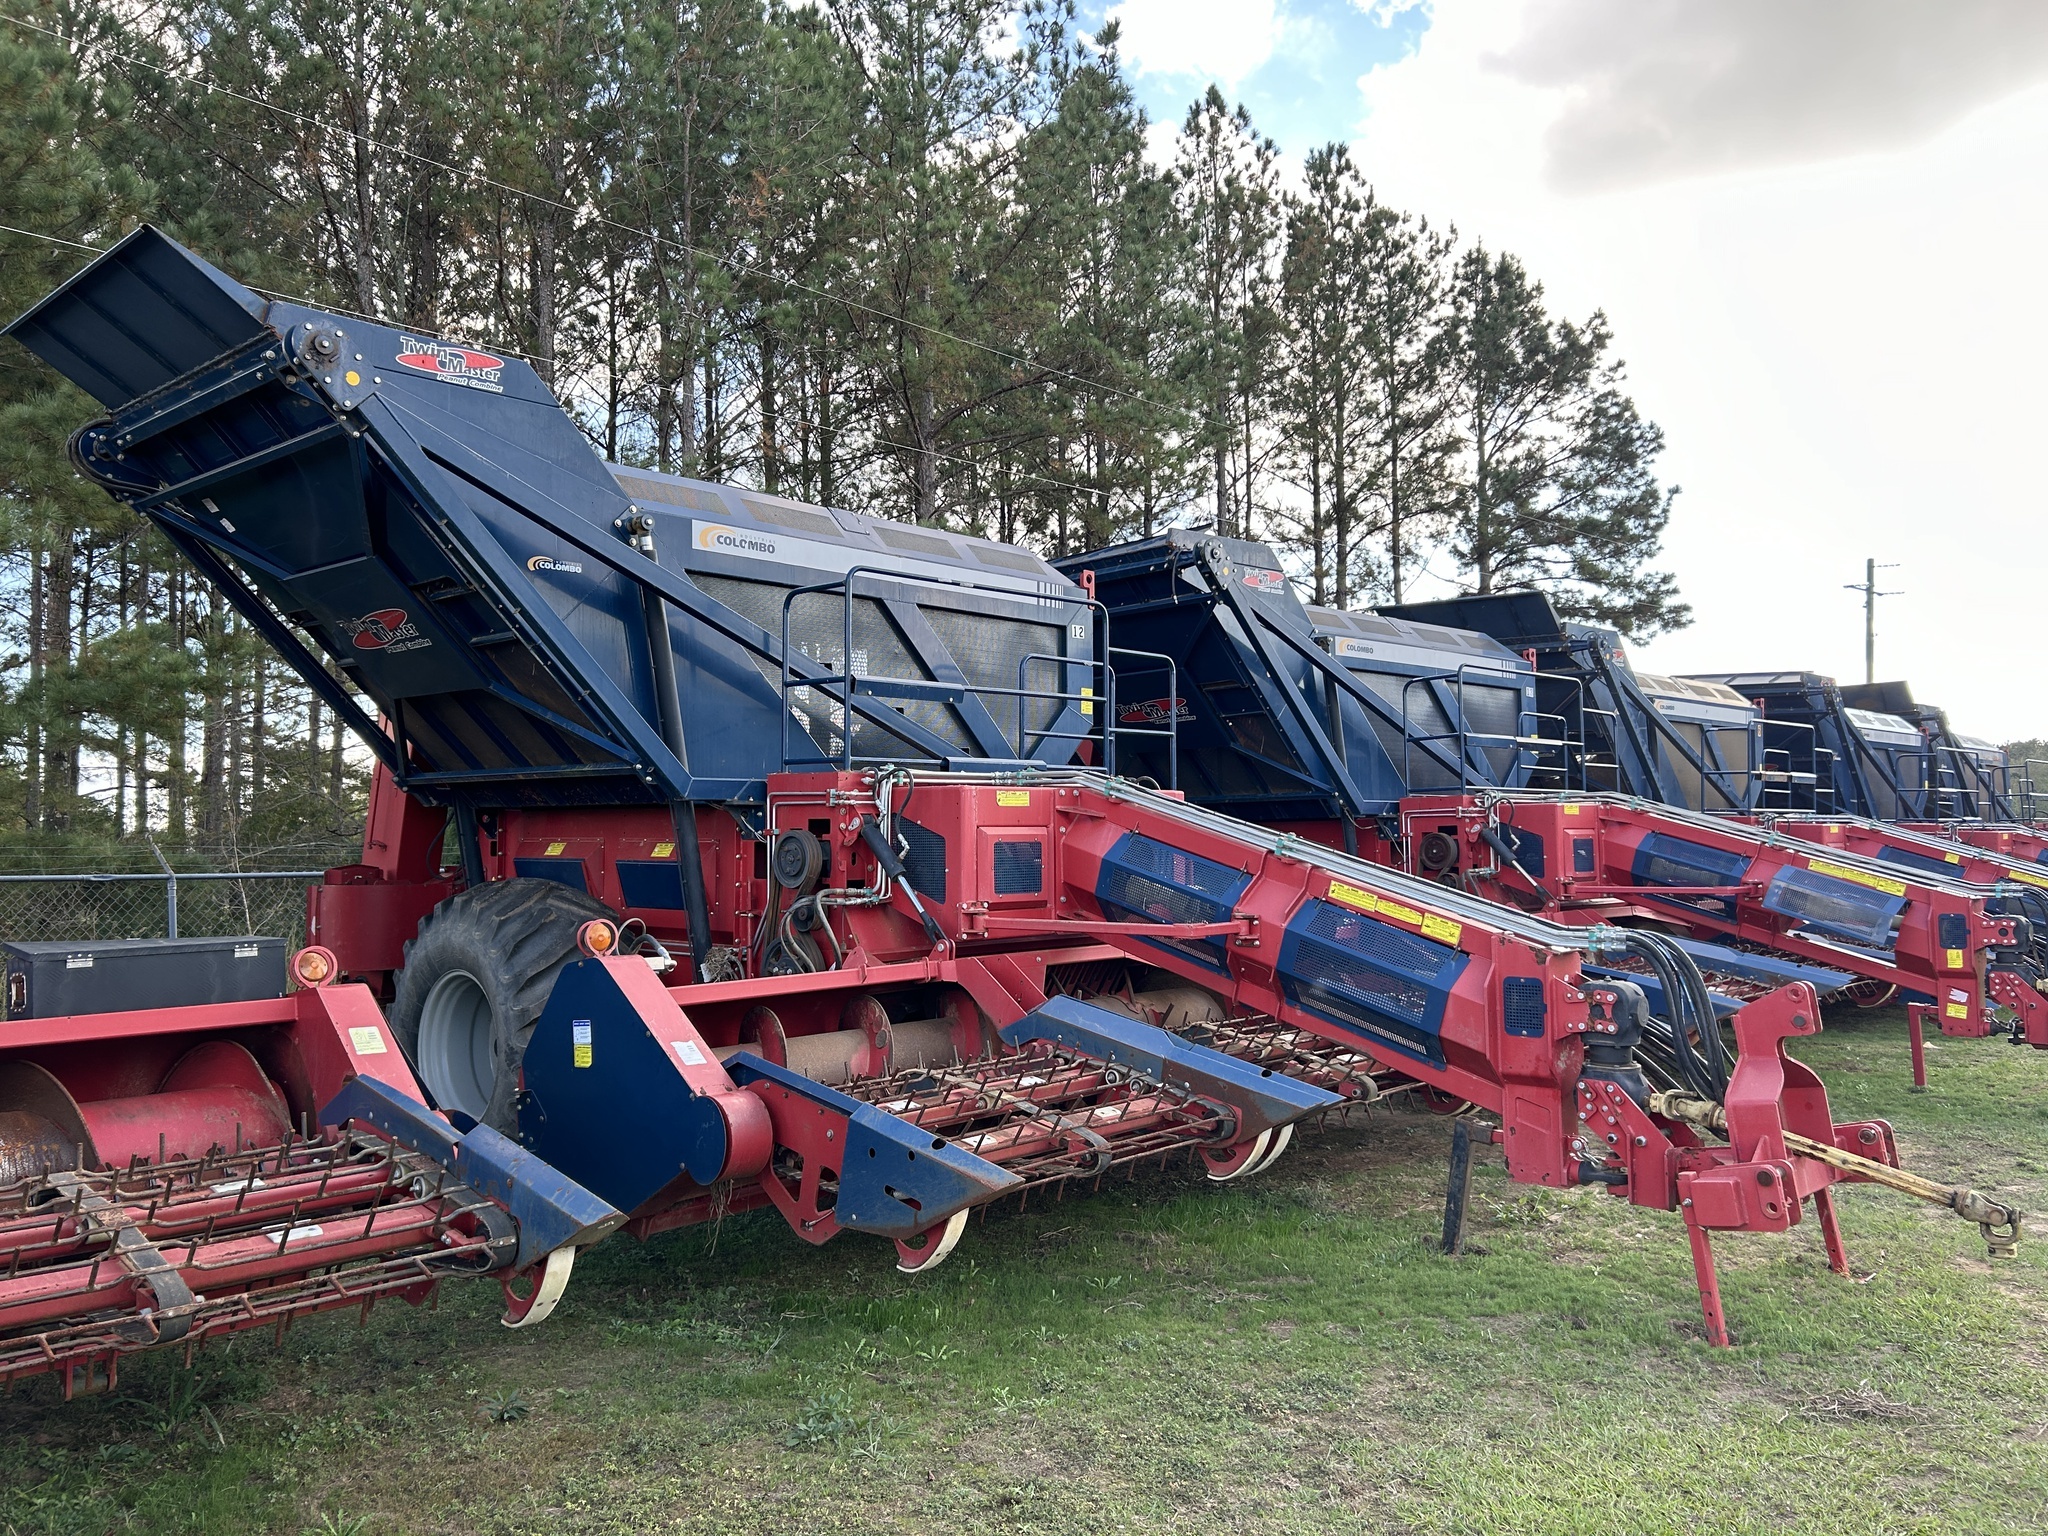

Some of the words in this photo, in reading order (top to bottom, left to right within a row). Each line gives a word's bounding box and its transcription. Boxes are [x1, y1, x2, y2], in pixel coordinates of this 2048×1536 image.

[401, 336, 449, 361] Twin
[447, 357, 500, 382] Master
[438, 373, 468, 385] Peanut
[469, 379, 503, 393] Combine
[716, 534, 776, 555] COLOMBO
[539, 561, 582, 574] COLOMBO
[374, 623, 419, 642] Master
[1073, 626, 1084, 638] 12
[1346, 644, 1374, 654] COLOMBO
